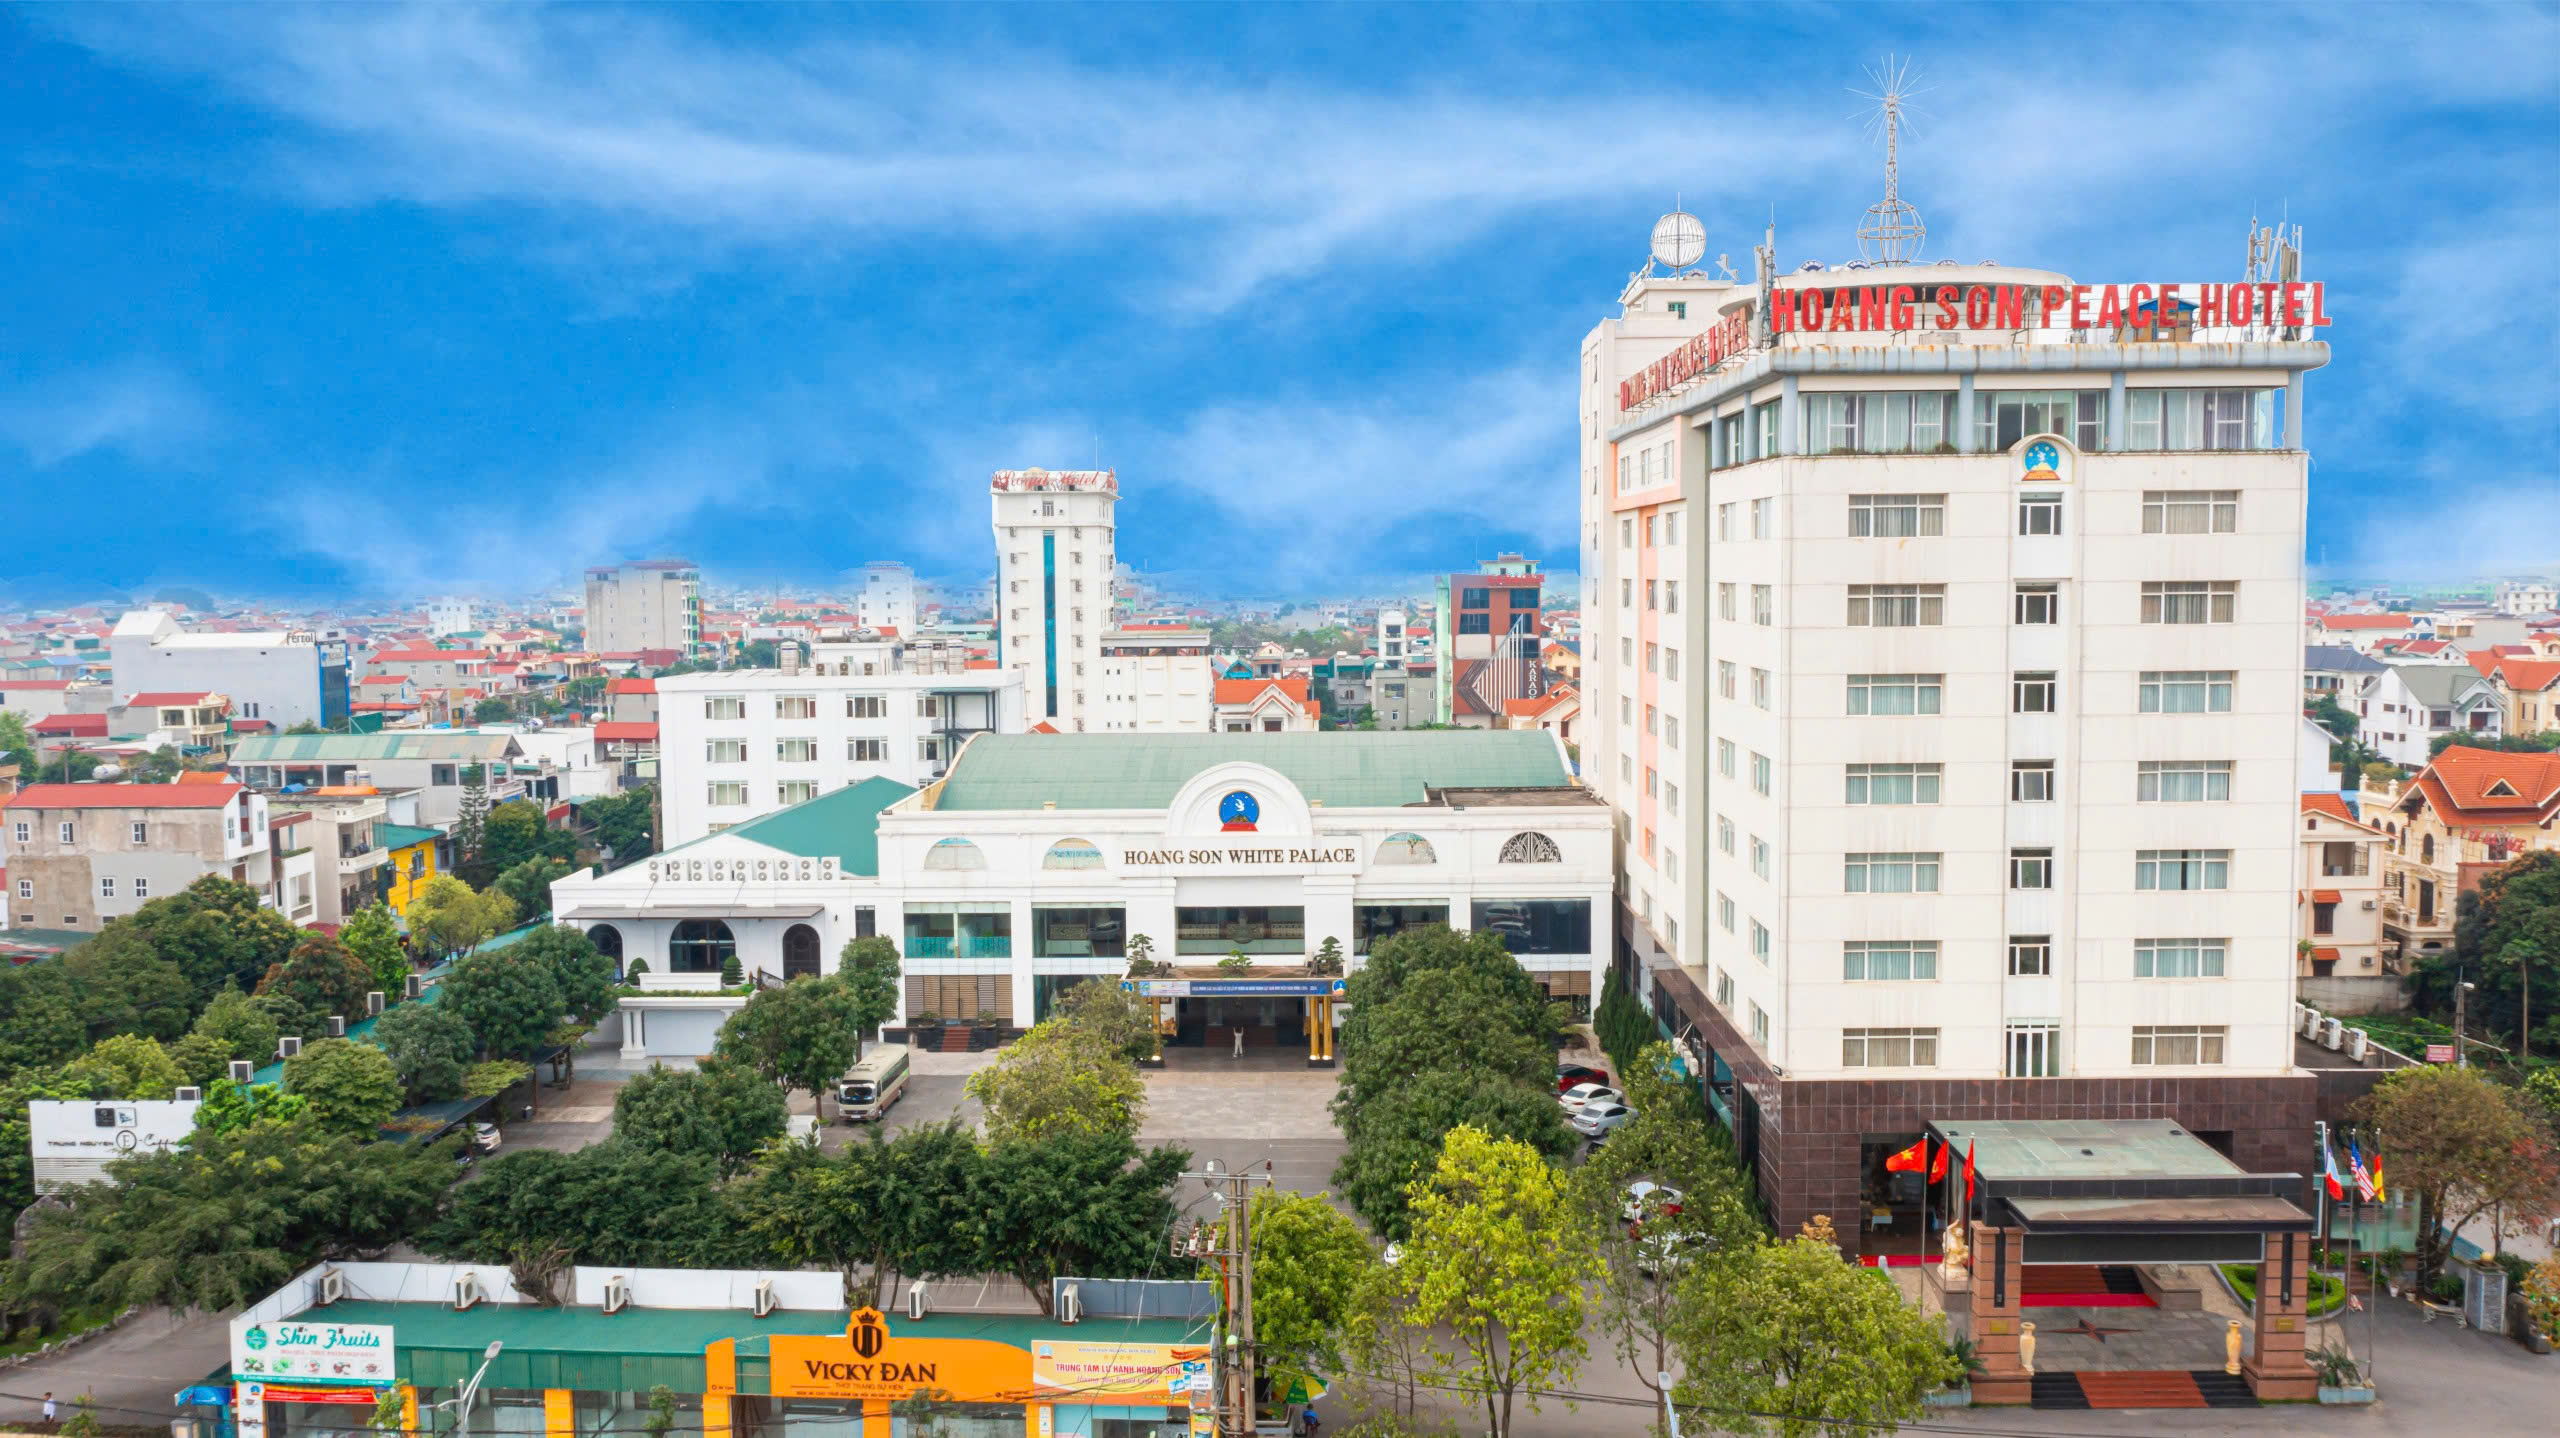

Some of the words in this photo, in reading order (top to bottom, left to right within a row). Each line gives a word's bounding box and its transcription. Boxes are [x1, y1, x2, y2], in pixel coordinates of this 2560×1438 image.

[1771, 284, 1915, 333] HOANG
[1935, 284, 2024, 331] SON
[2040, 282, 2180, 329] PEACE
[2200, 281, 2332, 327] HOTEL
[1124, 850, 1184, 865] HOANG
[1188, 850, 1222, 864] SON
[1228, 849, 1284, 864] WHITE
[1289, 848, 1355, 863] PALACE
[276, 1326, 318, 1346] Shin
[323, 1328, 380, 1349] Fruits
[804, 1360, 874, 1381] VICKY
[1056, 1363, 1081, 1372] TRUNG
